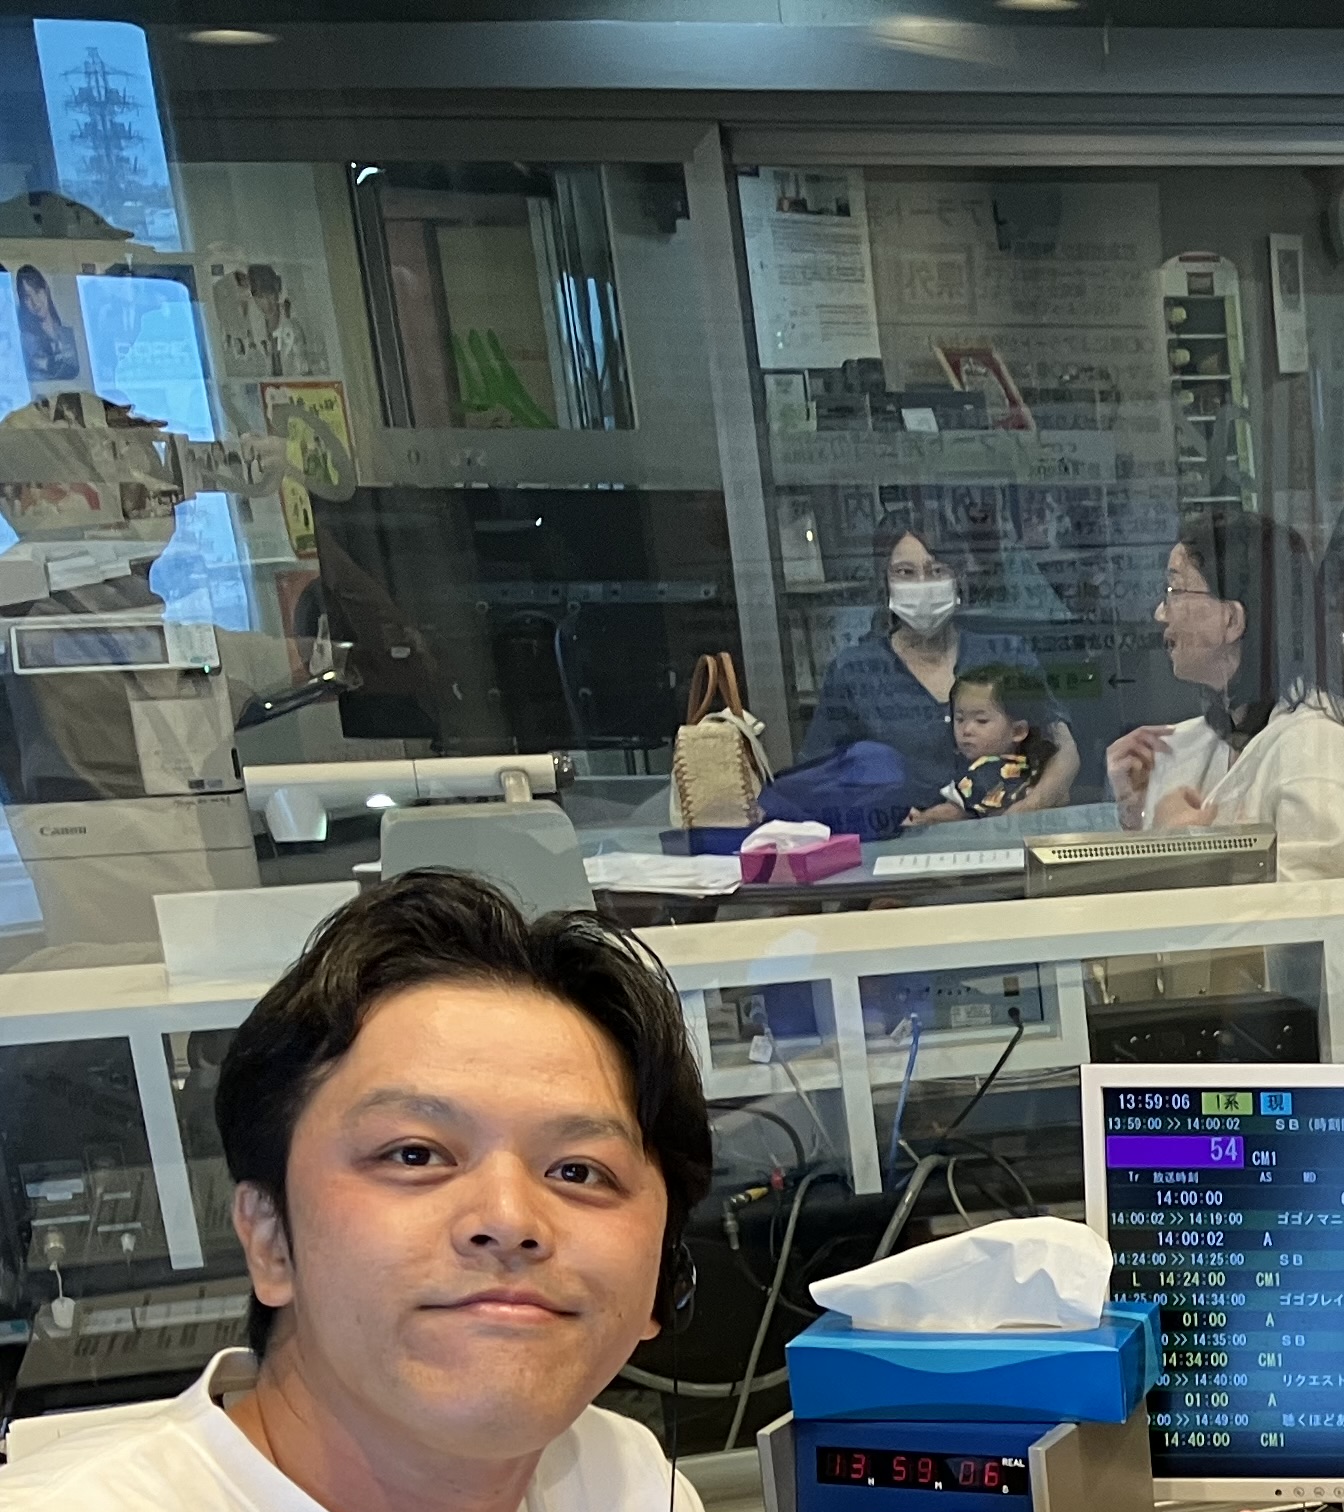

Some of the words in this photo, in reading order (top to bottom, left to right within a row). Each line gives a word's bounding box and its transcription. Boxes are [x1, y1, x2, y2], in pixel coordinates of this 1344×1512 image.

[40, 826, 87, 836] Canon
[1118, 1093, 1190, 1110] 13:59:06
[1267, 1094, 1283, 1111] 現
[1108, 1117, 1162, 1130] 13:59:00
[1187, 1117, 1241, 1130] 14:00:02
[1210, 1137, 1238, 1161] 54
[1252, 1151, 1276, 1166] CM1
[1153, 1172, 1199, 1184] 放送時刻
[1156, 1191, 1223, 1206] 14:00:00
[1112, 1212, 1164, 1225] 14:00:02
[1189, 1213, 1243, 1225] 14:19:00
[1278, 1213, 1343, 1225] ゴゴノマニ
[1157, 1232, 1224, 1247] 14:00:02
[1263, 1232, 1272, 1247] A
[1113, 1253, 1167, 1265] 14:24:00
[1191, 1254, 1245, 1265] 14:25:00
[1132, 1272, 1140, 1286] L
[1159, 1272, 1225, 1287] 14:24:00
[1256, 1272, 1280, 1286] CM1
[1192, 1294, 1246, 1306] 14:34:00
[1182, 1313, 1226, 1327] 01:00
[1266, 1313, 1275, 1327] A
[1193, 1334, 1247, 1346] 14:35:00
[1162, 1352, 1228, 1367] 14:34:00
[1258, 1353, 1282, 1367] CM1
[1195, 1374, 1248, 1386] 14:40:00
[1184, 1393, 1229, 1407] 01:00
[1268, 1393, 1277, 1407] A
[1195, 1414, 1249, 1426] 14:49:00
[1164, 1432, 1230, 1447] 14:40:00
[1260, 1433, 1285, 1447] CM1
[1002, 1457, 1025, 1468] REAL
[834, 1454, 866, 1479] 13
[892, 1456, 933, 1483] 59
[959, 1460, 999, 1487] 06
